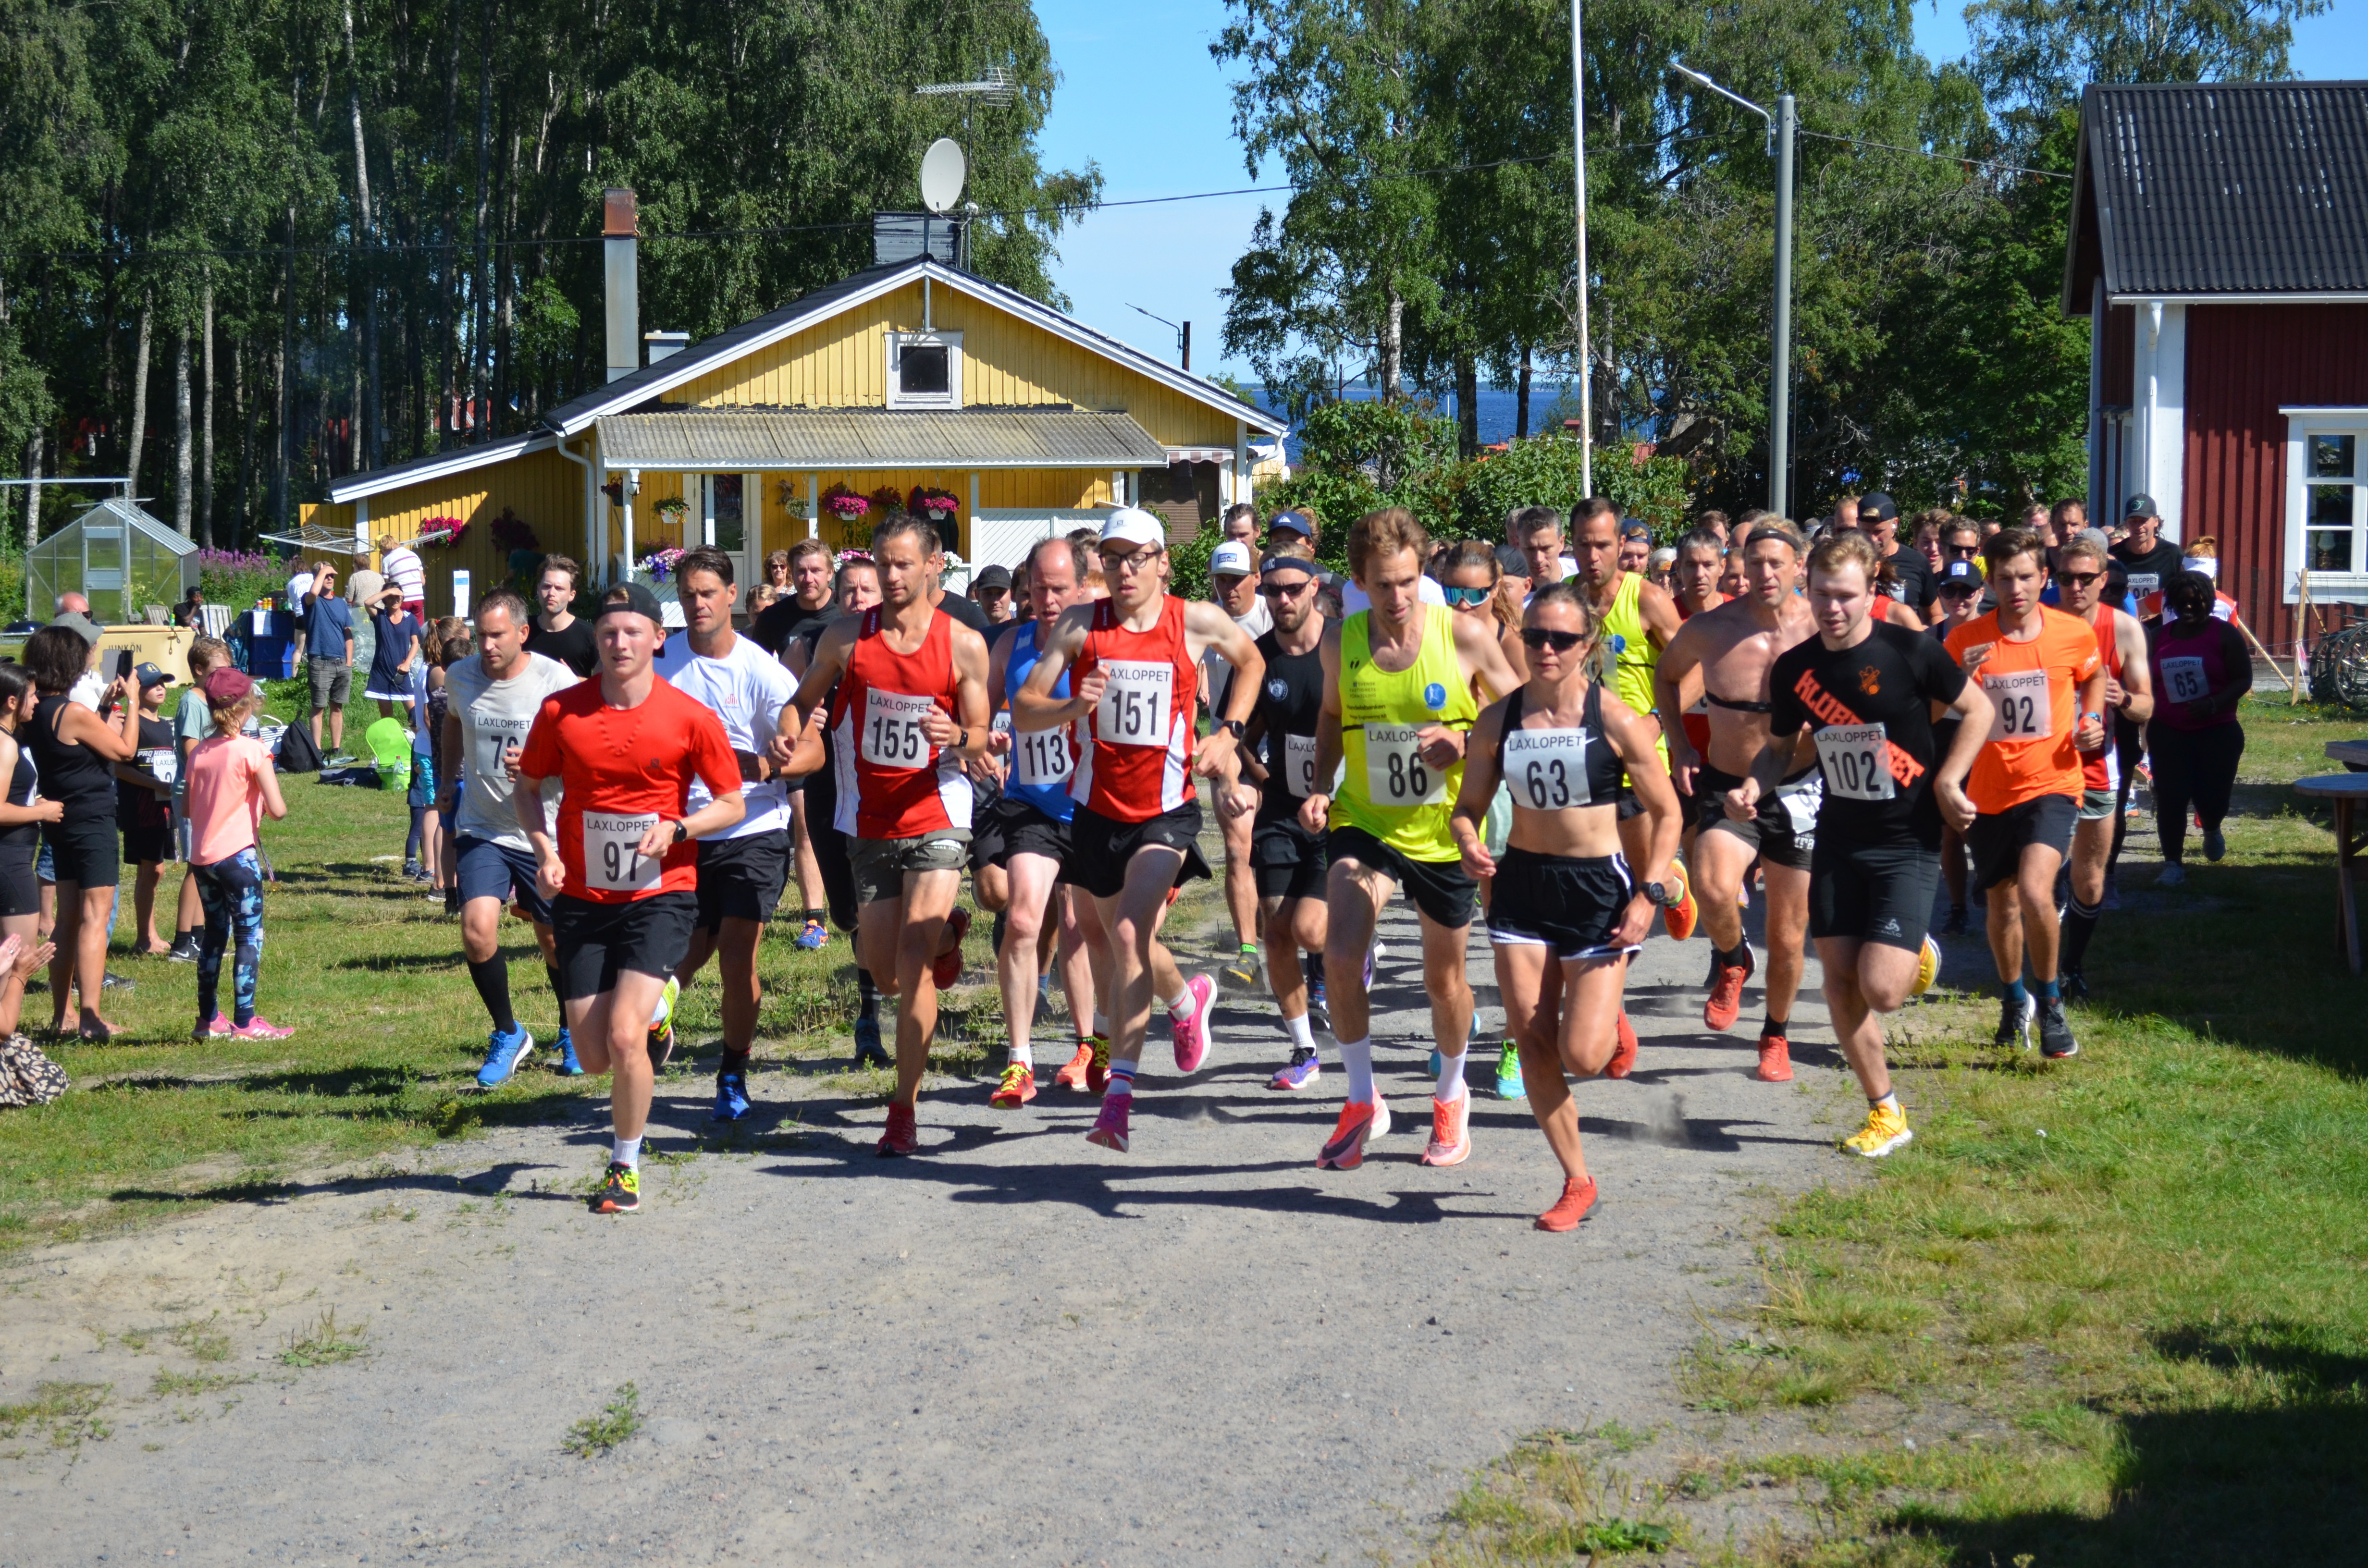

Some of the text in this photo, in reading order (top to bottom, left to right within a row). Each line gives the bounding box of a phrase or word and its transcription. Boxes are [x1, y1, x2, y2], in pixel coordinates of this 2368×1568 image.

[1110, 668, 1171, 682] AXLOPPET
[2163, 660, 2200, 669] LAXLOPPET
[1986, 676, 2045, 690] LAXLOPPET
[2174, 672, 2198, 697] 65
[870, 695, 932, 713] LAXLOPPET
[1112, 690, 1158, 736] 151
[478, 717, 531, 729] LAXLOPPET
[2002, 696, 2036, 734] 92
[873, 716, 919, 760] 155
[1369, 730, 1419, 742] LAXLOP
[1509, 736, 1582, 751] LAXLOPPET
[1817, 730, 1882, 743] LAXLOPPET
[1025, 735, 1066, 777] 113
[1388, 752, 1428, 798] 86
[1828, 751, 1881, 792] 102
[1527, 759, 1569, 809] 63
[587, 818, 656, 832] LAXLOPPET
[604, 841, 641, 882] 97
